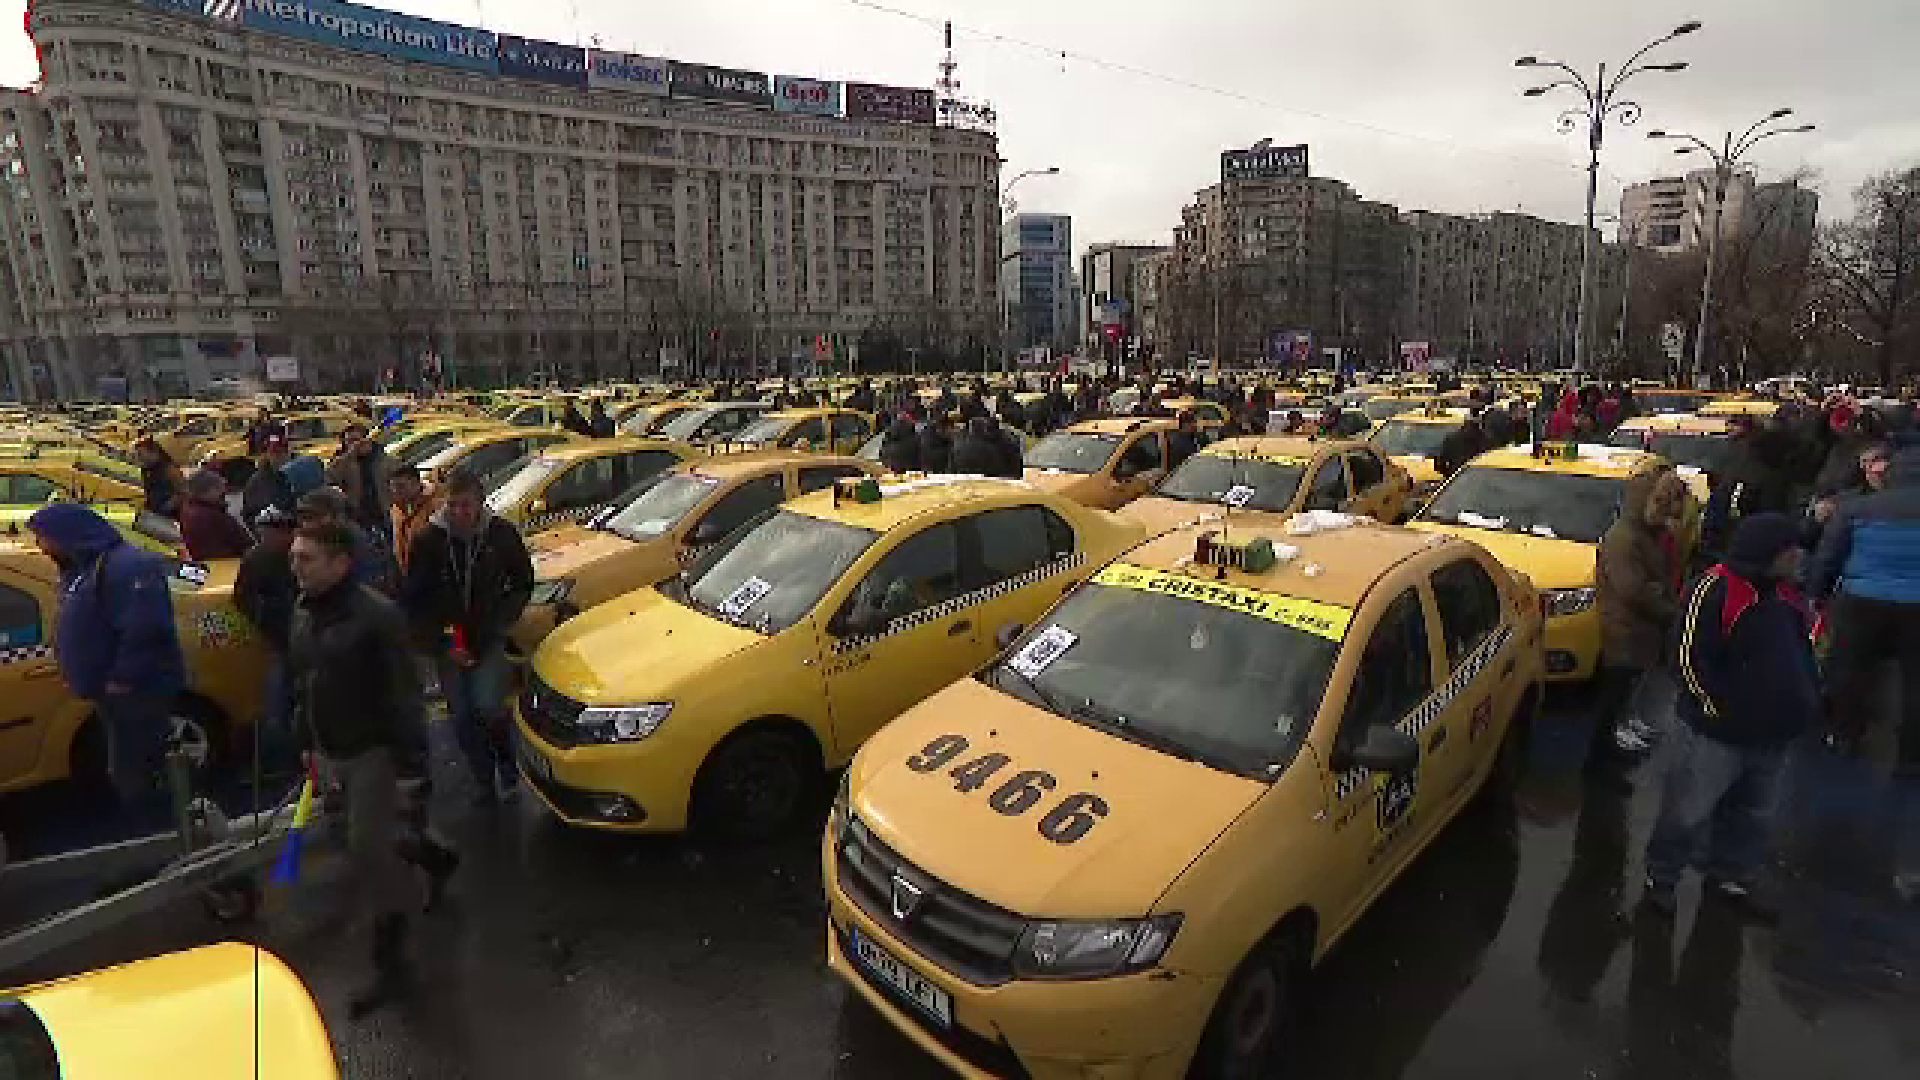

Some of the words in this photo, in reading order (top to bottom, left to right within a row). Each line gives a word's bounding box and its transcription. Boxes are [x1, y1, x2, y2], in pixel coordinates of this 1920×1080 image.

[444, 33, 494, 59] Life
[1148, 575, 1271, 614] CRISTAXI
[905, 734, 1110, 845] 9466
